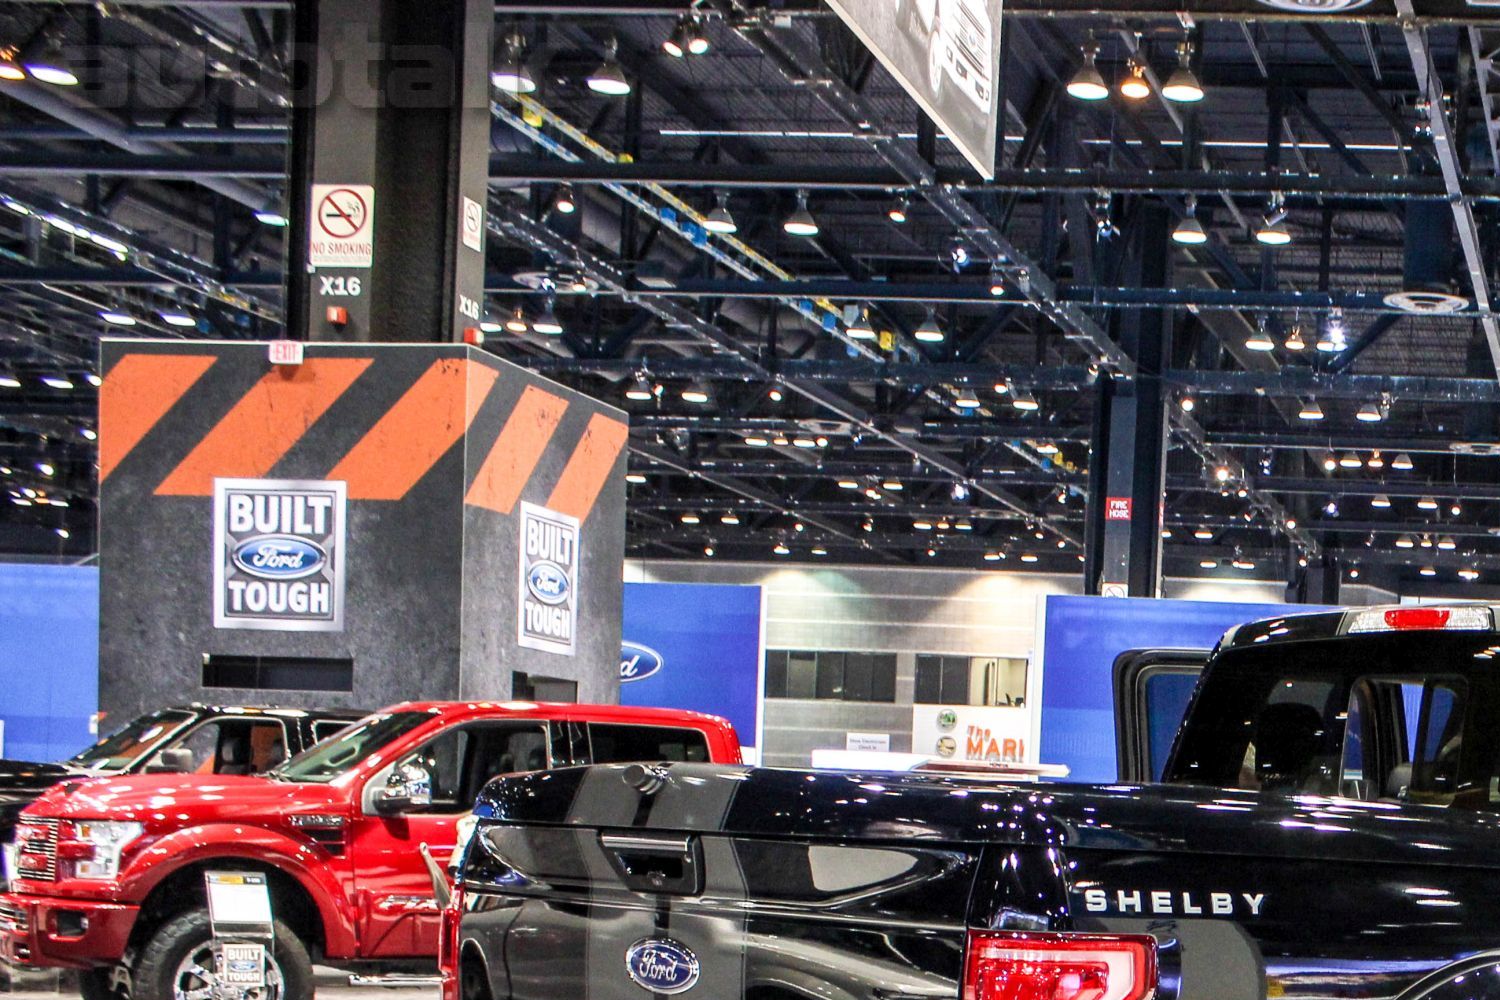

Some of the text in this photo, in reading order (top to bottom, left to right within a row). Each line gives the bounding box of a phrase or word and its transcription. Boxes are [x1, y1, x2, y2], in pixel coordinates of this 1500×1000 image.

[312, 242, 372, 255] NO SMOKING
[320, 276, 361, 296] X16
[459, 295, 480, 320] X16
[275, 343, 298, 361] EXIT
[229, 494, 332, 534] BUILT
[1109, 510, 1129, 518] HOSE
[1110, 501, 1128, 509] FIRE
[526, 520, 574, 563] BUILT
[252, 545, 304, 569] Ford
[535, 569, 560, 595] Ford
[227, 580, 329, 613] TOUGH
[524, 601, 571, 640] TOUGH
[1084, 889, 1266, 915] SHELBY
[228, 948, 260, 961] BUILT
[639, 950, 678, 982] Ford
[228, 972, 260, 982] TOUGH
